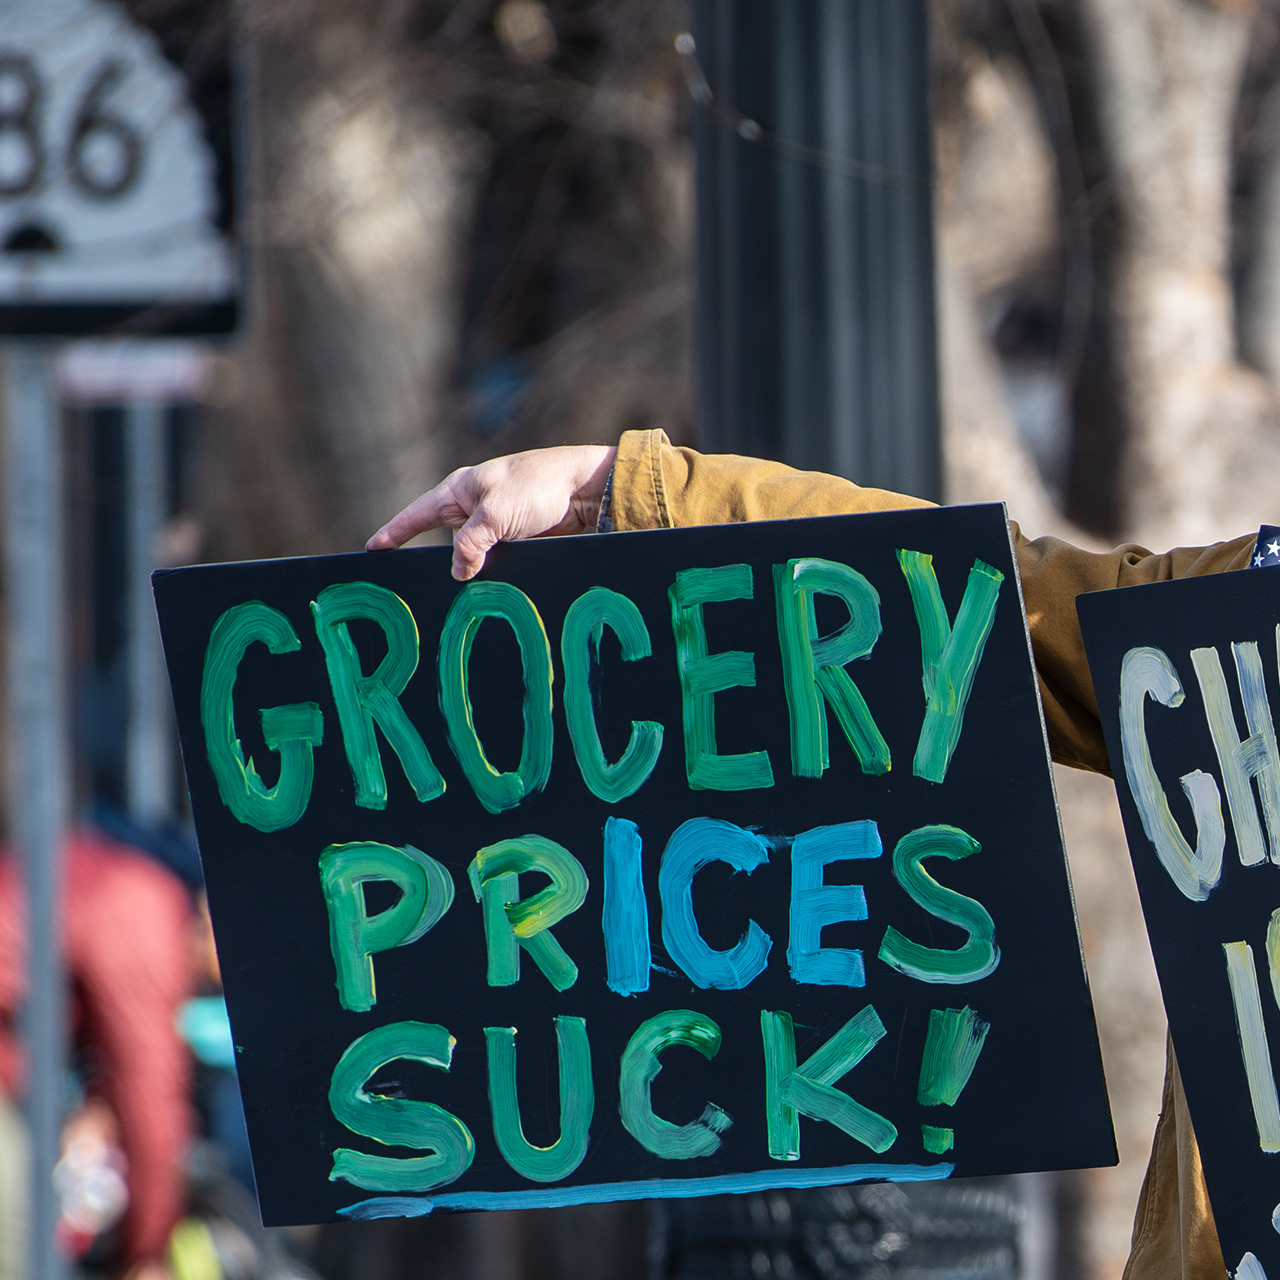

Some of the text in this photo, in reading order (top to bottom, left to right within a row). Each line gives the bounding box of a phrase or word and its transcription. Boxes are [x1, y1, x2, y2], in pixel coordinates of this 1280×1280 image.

[200, 548, 1005, 833] GROCERY
[318, 815, 1000, 1012] PRICES
[327, 1002, 991, 1193] SUCK!
